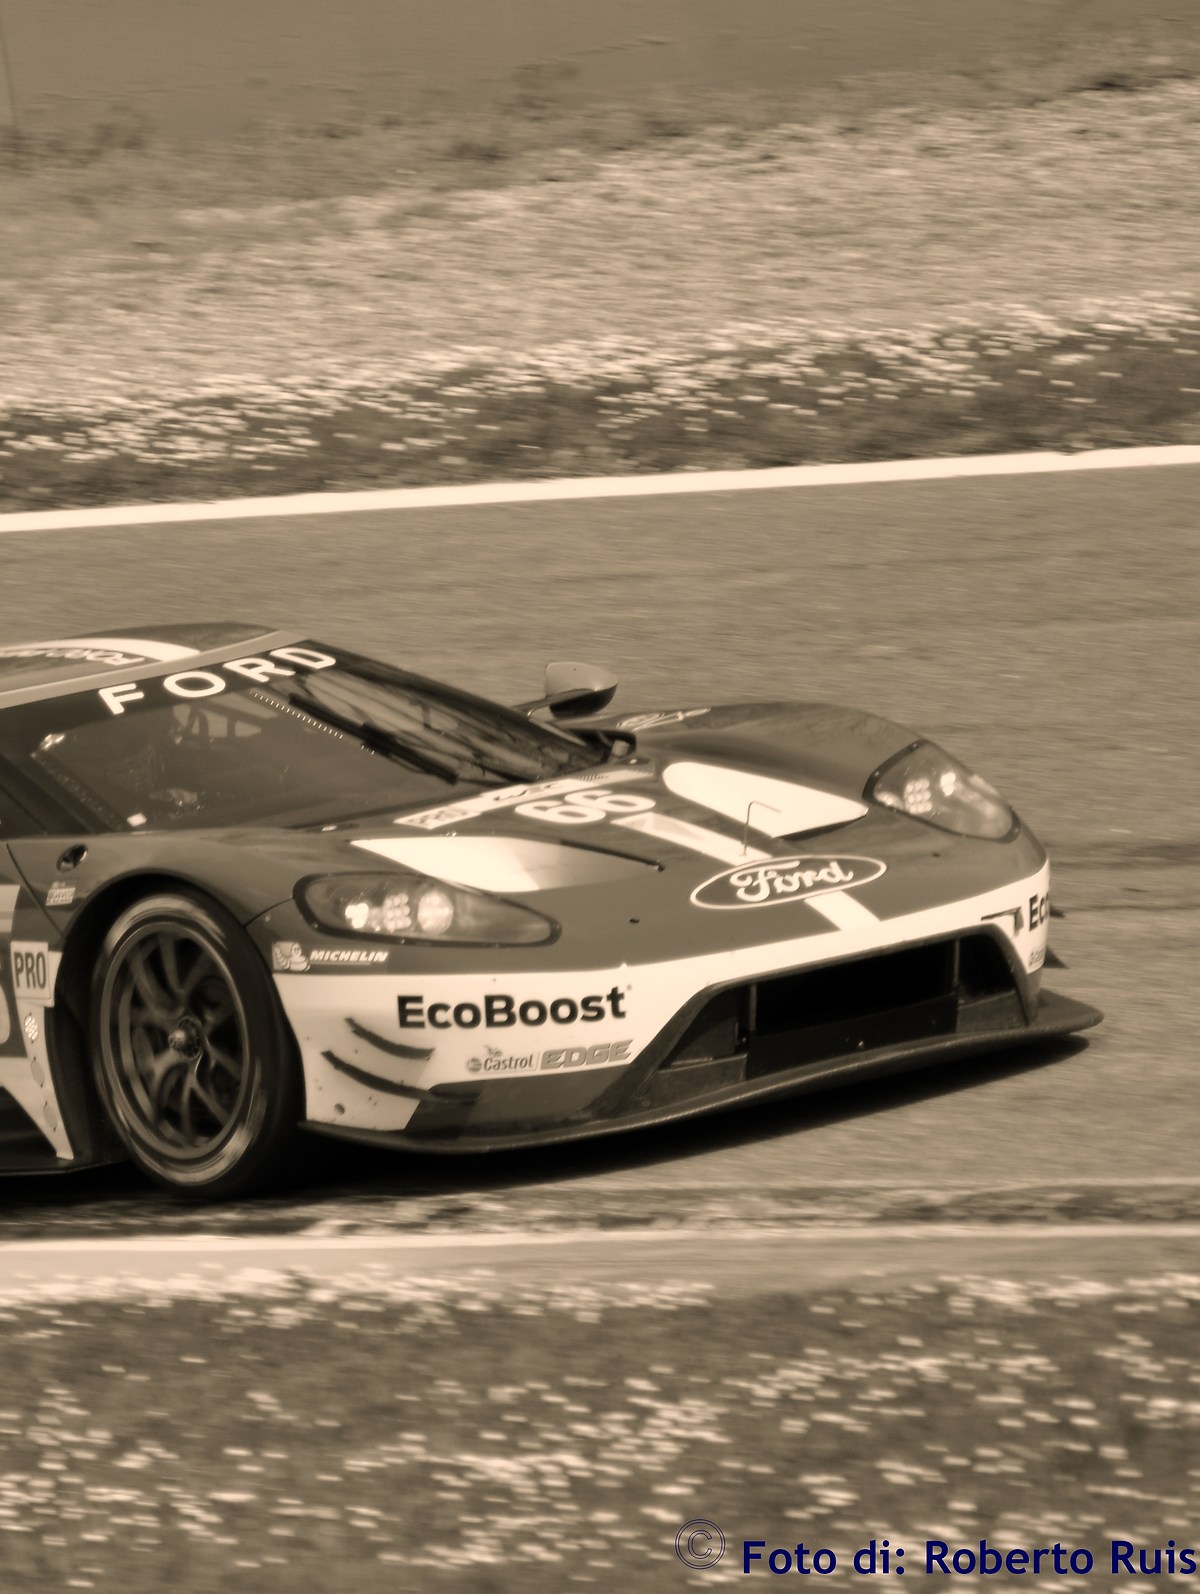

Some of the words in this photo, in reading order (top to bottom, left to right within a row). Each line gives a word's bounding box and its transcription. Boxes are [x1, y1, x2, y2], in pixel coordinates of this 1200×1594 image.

[97, 646, 337, 716] FORD
[514, 789, 656, 824] 66
[729, 860, 855, 902] Ford
[12, 951, 47, 989] PRO
[309, 949, 390, 964] MICHELIN
[397, 985, 628, 1029] EcoBoost
[483, 1053, 534, 1072] Castrol
[540, 1039, 634, 1070] EDGE
